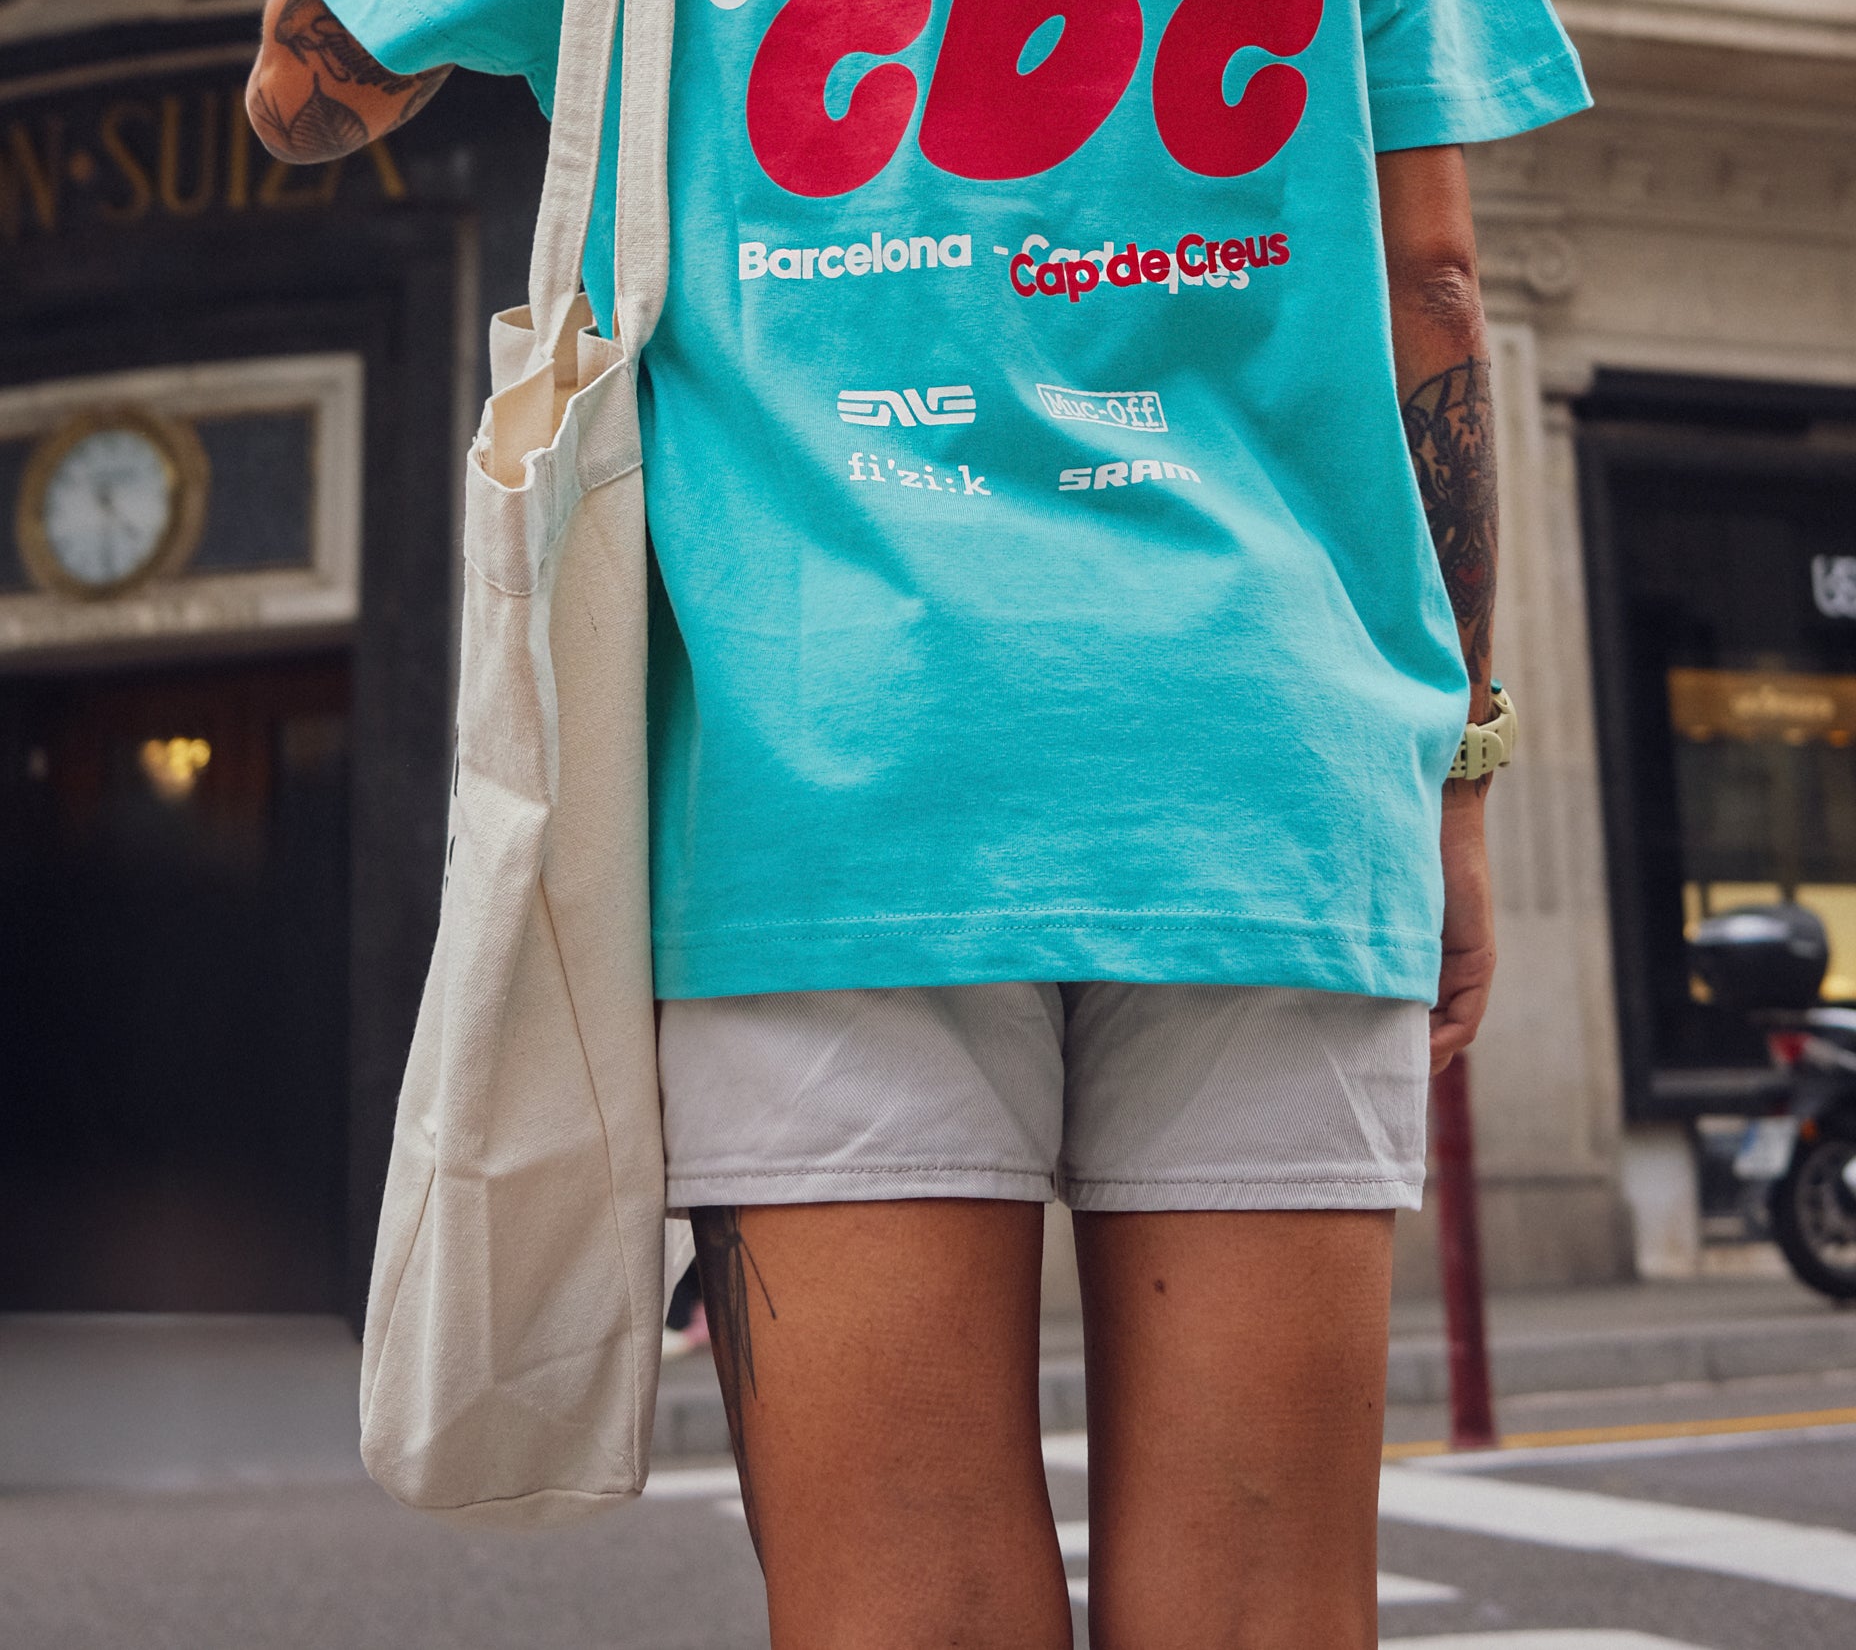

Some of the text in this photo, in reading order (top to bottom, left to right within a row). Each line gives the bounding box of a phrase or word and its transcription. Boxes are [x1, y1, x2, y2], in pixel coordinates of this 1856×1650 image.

[738, 232, 972, 281] Barcelona
[1176, 233, 1290, 278] Creus
[1043, 390, 1162, 428] Muc-Off
[1058, 459, 1202, 491] SRAM
